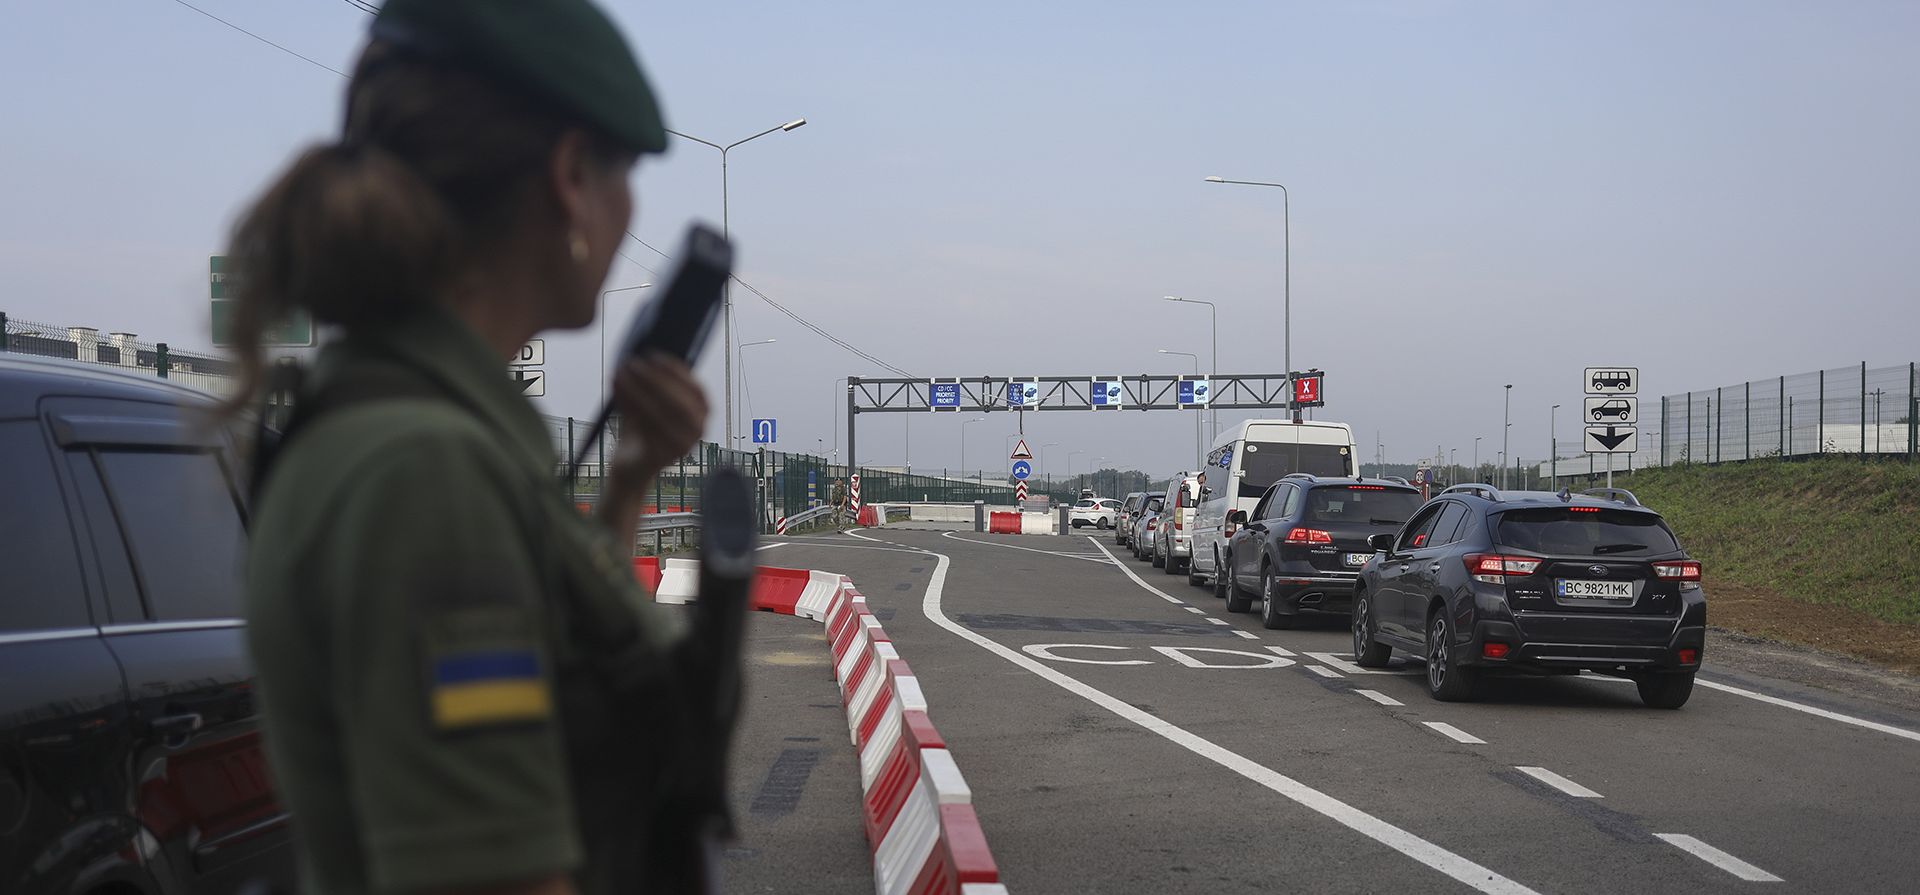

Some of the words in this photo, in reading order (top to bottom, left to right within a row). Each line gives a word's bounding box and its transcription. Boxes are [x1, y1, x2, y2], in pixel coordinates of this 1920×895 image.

[1566, 582, 1581, 593] BC
[1584, 583, 1610, 594] 9821
[1612, 584, 1628, 595] MK
